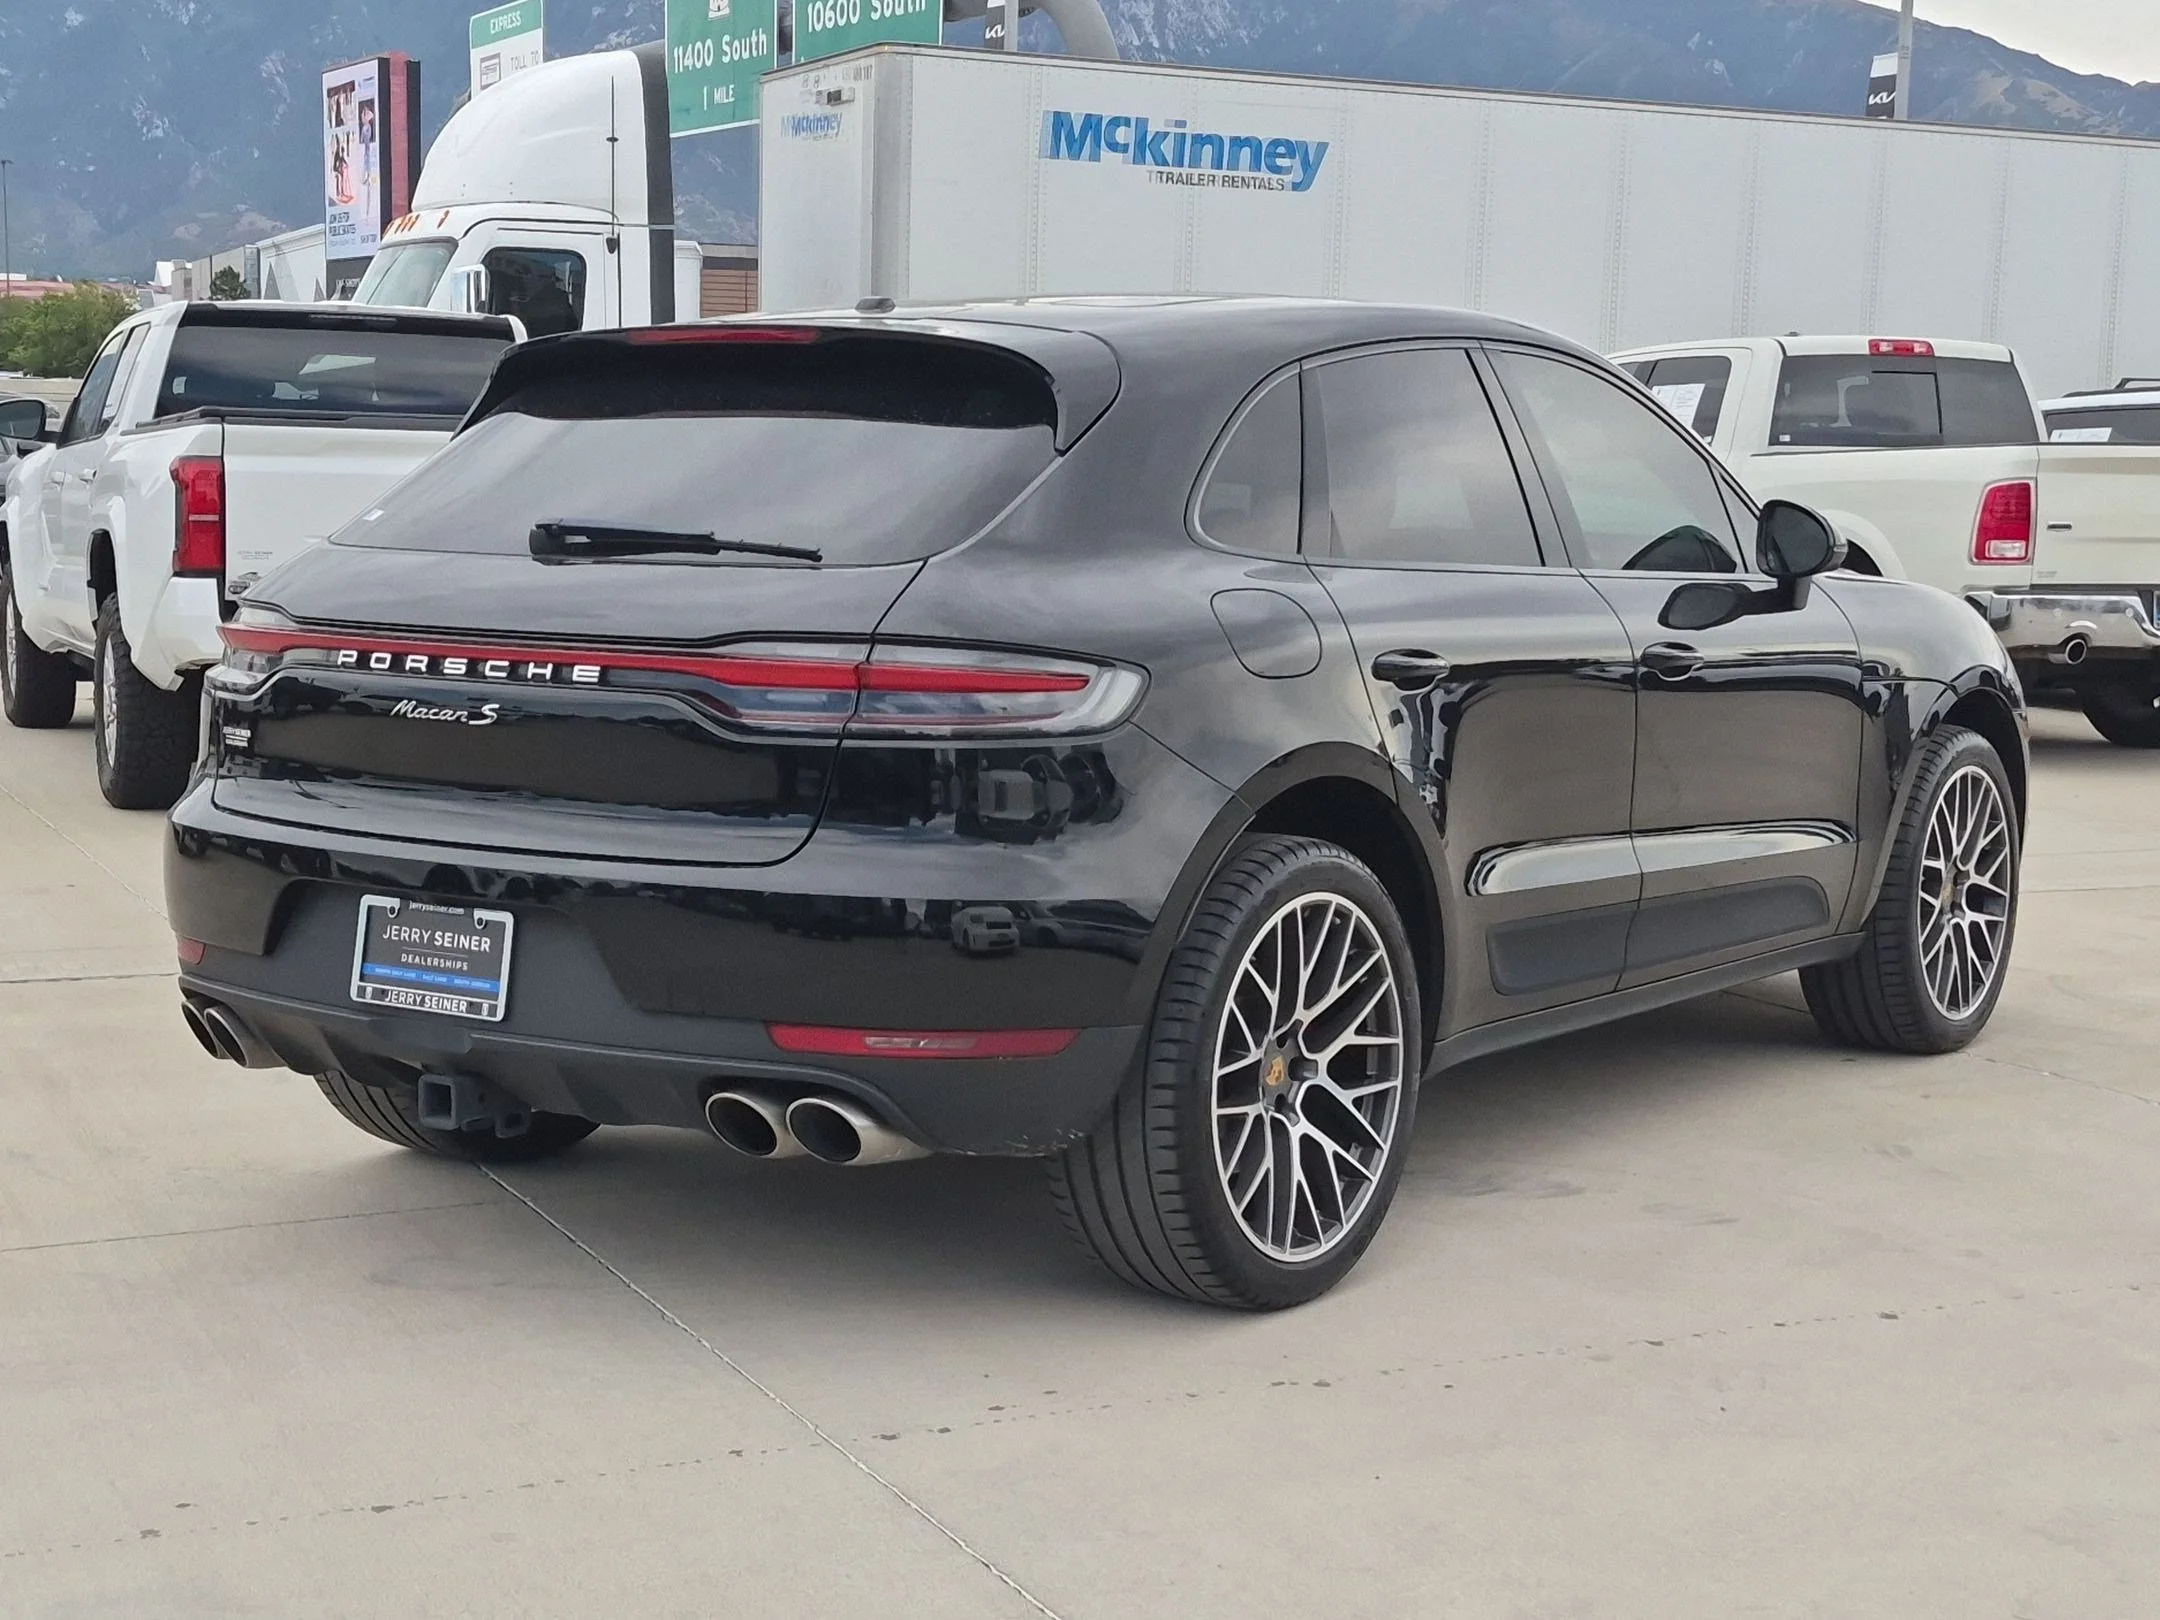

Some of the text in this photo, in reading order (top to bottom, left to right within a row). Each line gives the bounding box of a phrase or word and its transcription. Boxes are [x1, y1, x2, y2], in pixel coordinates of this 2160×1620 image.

[490, 10, 522, 35] EXPRESS
[807, 0, 861, 33] 10600
[673, 27, 767, 74] 11400 South
[703, 84, 736, 111] 1 MILE
[1154, 170, 1286, 191] TRAILER RENTALS
[337, 649, 602, 684] PORSCHE
[390, 699, 500, 725] Macan S
[409, 900, 465, 915] jerryseiner.com
[382, 924, 491, 952] JERRY SEINER
[400, 953, 469, 971] DEALERSHIPS
[384, 989, 468, 1013] JERRY SEINER
